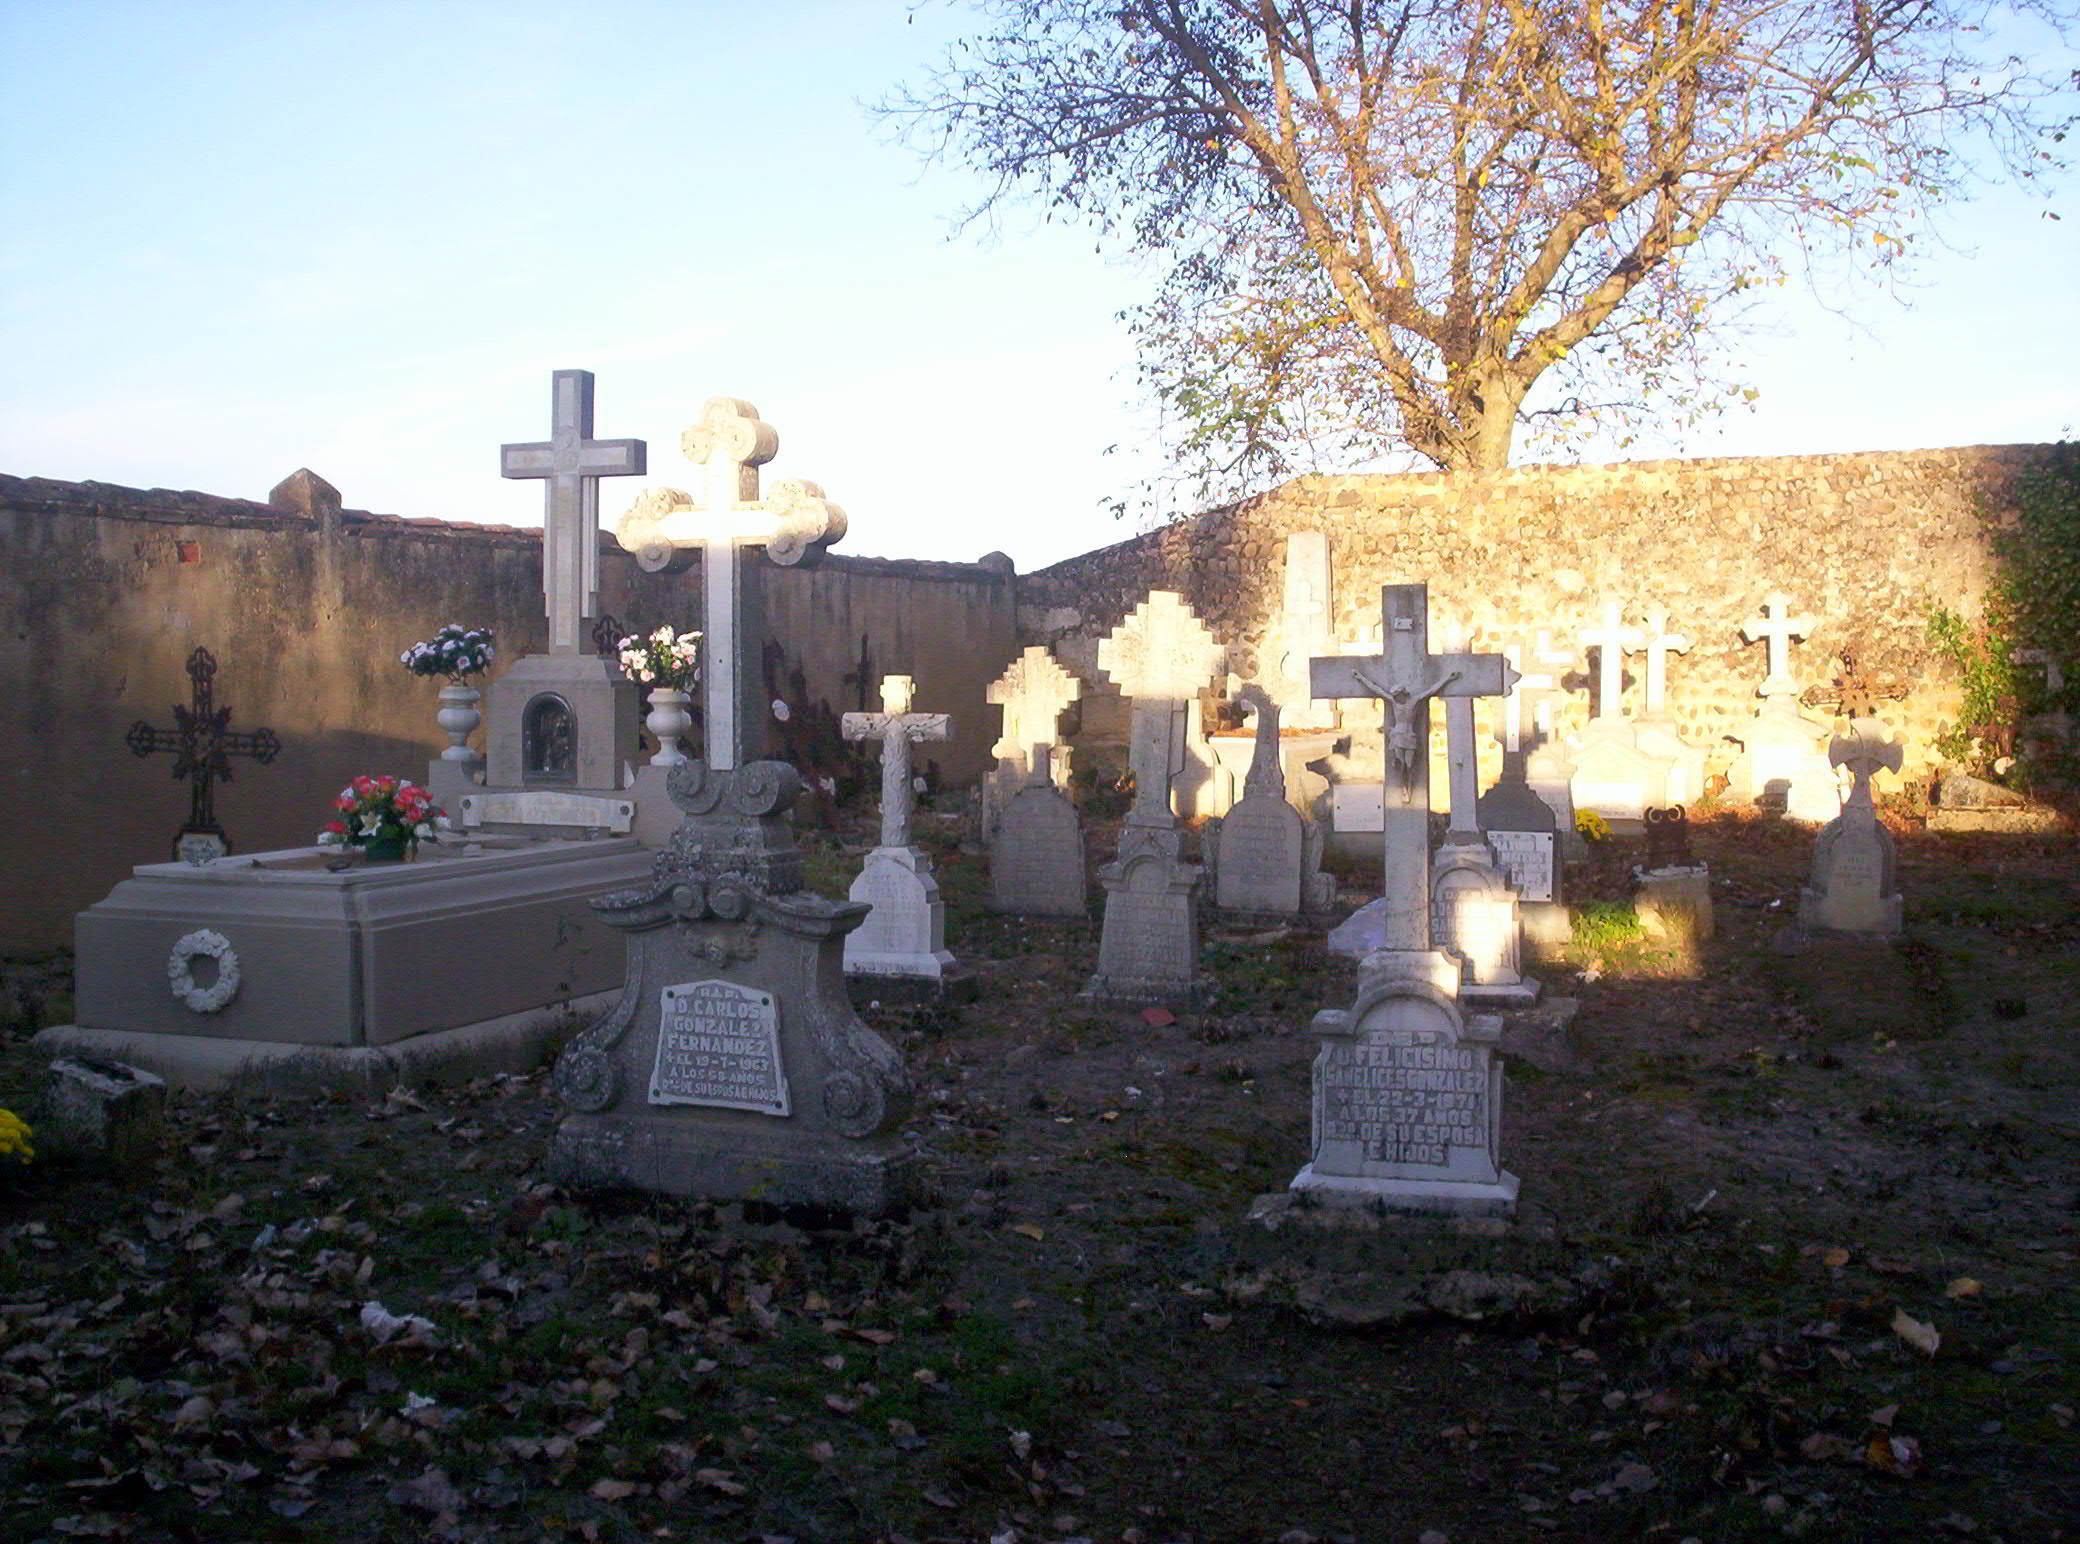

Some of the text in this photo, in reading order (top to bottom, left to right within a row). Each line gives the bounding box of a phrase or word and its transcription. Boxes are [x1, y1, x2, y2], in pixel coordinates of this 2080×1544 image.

[694, 1000, 761, 1018] CARLOS
[674, 1016, 762, 1037] GONZALEZ
[667, 1034, 767, 1057] FERNANDEZ
[669, 1066, 678, 1077] A
[682, 1067, 705, 1080] LOS
[1360, 1122, 1383, 1141] DE
[1385, 1123, 1410, 1143] SU
[1413, 1125, 1483, 1146] ESPOSA
[1385, 1142, 1444, 1163] HIJOS
